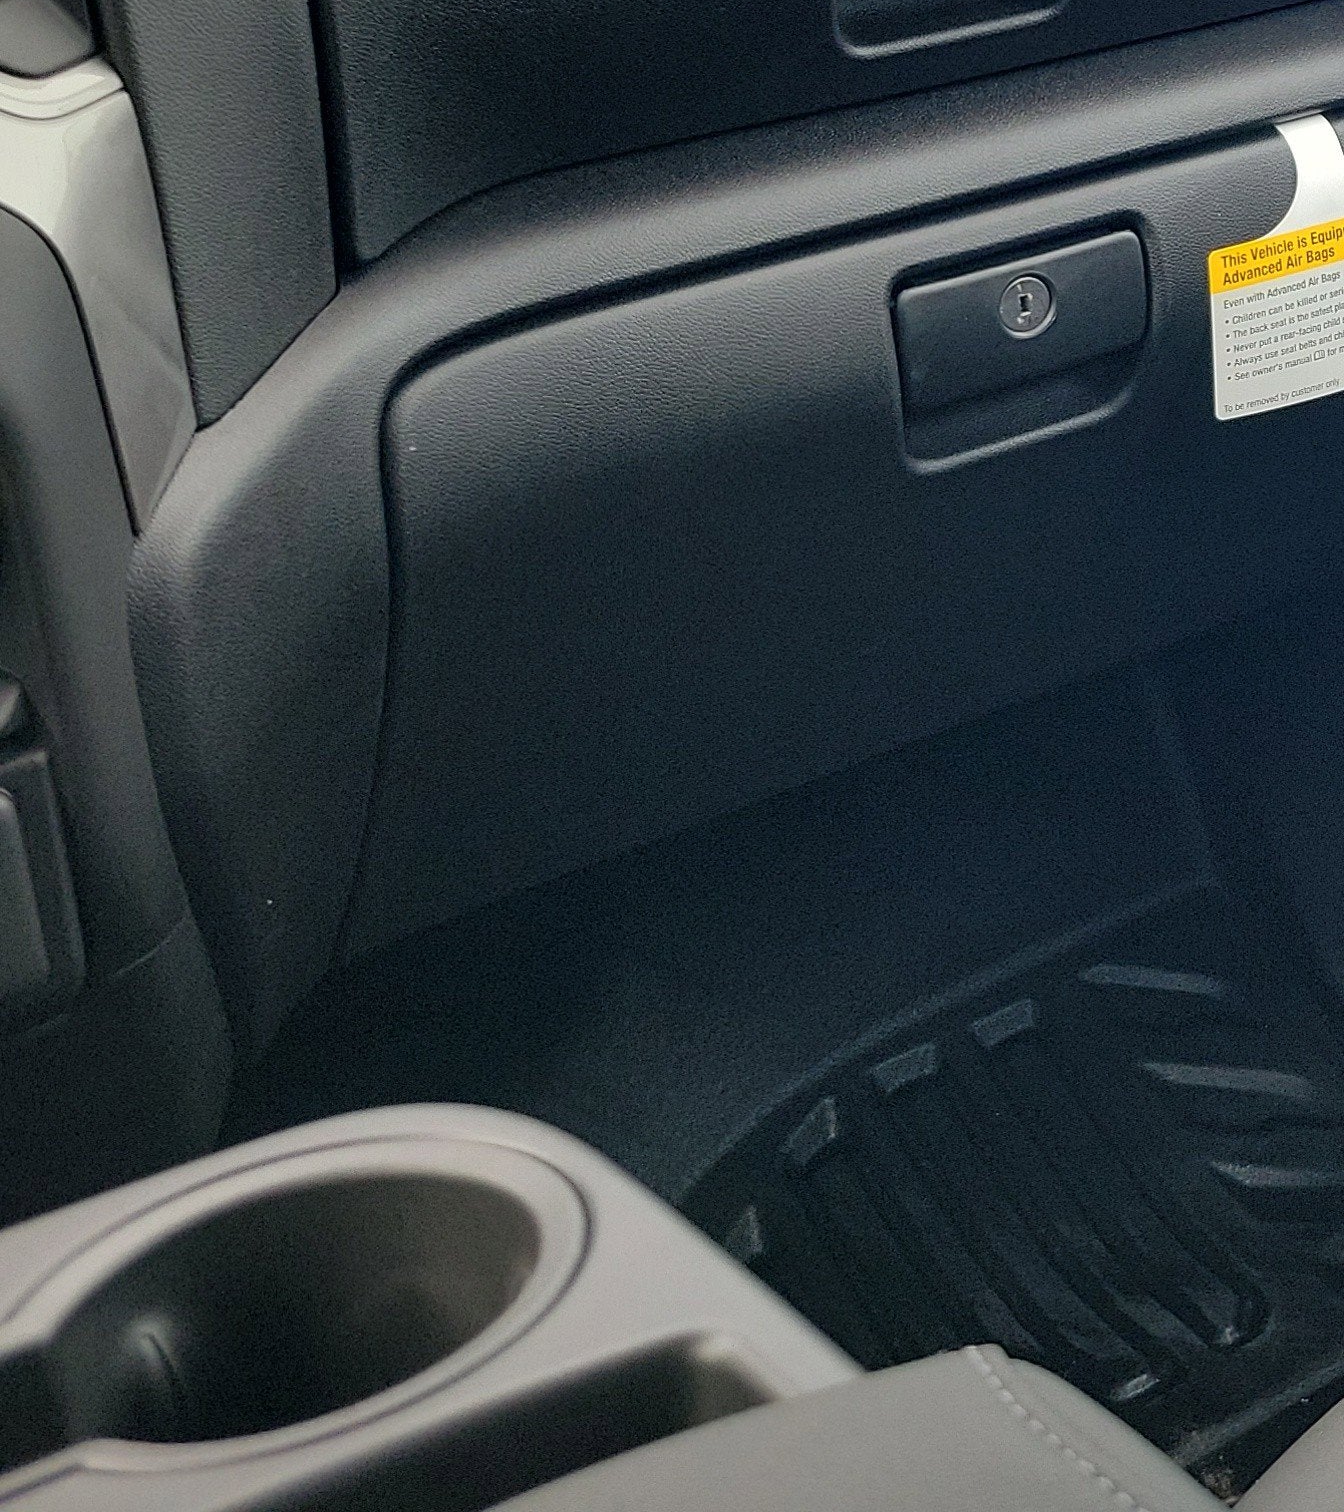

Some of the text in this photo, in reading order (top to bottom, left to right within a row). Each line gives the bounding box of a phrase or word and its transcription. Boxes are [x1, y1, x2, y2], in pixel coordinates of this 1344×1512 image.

[1221, 252, 1247, 268] This
[1250, 239, 1294, 261] Vehicle
[1297, 236, 1308, 248] is
[1223, 246, 1336, 286] Advanced Air Bags
[1223, 271, 1341, 310] Even with Advanced Air Bags
[1232, 309, 1267, 325] Children
[1268, 305, 1283, 315] can
[1285, 301, 1295, 311] be
[1297, 294, 1318, 307] killed
[1319, 293, 1328, 301] or
[1232, 329, 1248, 339] The
[1250, 324, 1269, 335] back
[1270, 318, 1287, 330] seat
[1288, 316, 1296, 324] is
[1297, 312, 1309, 322] the
[1310, 304, 1333, 316] safest
[1233, 341, 1257, 353] Never
[1259, 337, 1272, 348] put
[1273, 335, 1279, 343] a
[1280, 324, 1322, 341] rear-facing
[1323, 316, 1341, 329] child
[1233, 354, 1263, 368] Always
[1265, 350, 1279, 360] use
[1281, 344, 1297, 356] seat
[1299, 339, 1317, 350] belts
[1318, 334, 1333, 345] and
[1234, 372, 1250, 381] See
[1252, 363, 1283, 377] owner's
[1285, 354, 1312, 368] manual
[1327, 348, 1337, 357] for
[1224, 404, 1233, 413] To
[1235, 401, 1244, 410] be
[1246, 393, 1279, 408] removed
[1280, 392, 1290, 402] by
[1291, 382, 1324, 398] customer
